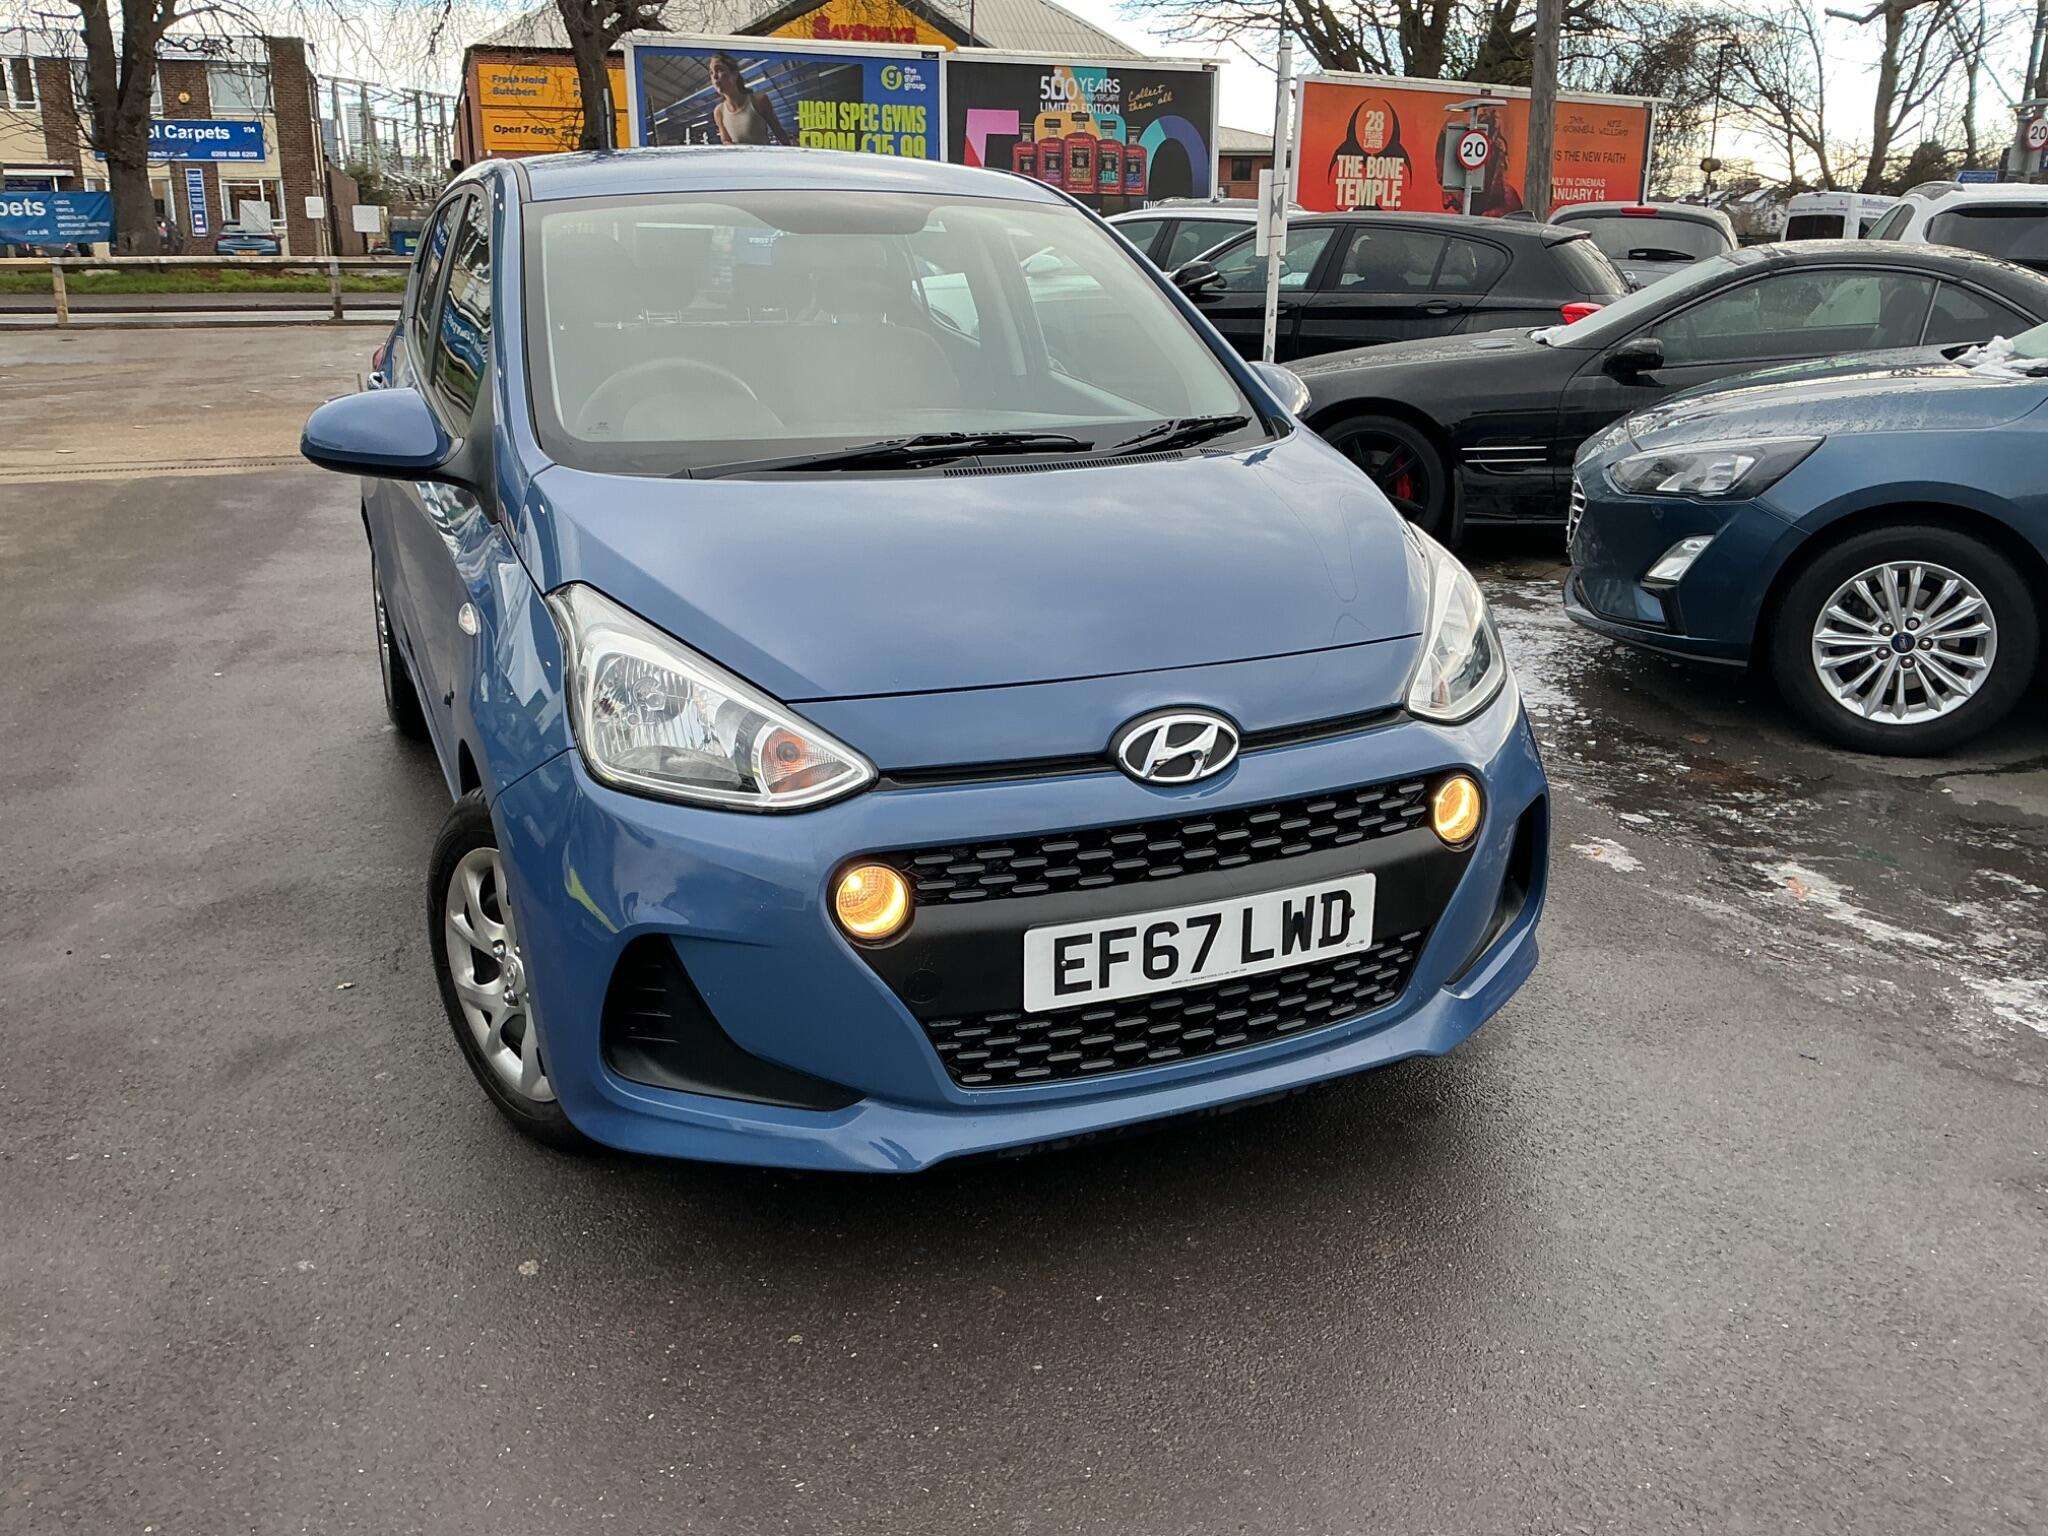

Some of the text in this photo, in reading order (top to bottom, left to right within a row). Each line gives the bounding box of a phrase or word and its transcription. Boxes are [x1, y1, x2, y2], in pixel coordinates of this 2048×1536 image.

[904, 67, 917, 75] the
[492, 74, 519, 84] Fresh
[904, 75, 921, 83] gym
[1079, 77, 1121, 94] YEARS
[492, 87, 537, 96] Butchers
[904, 83, 926, 92] group
[1128, 85, 1165, 102] Collect
[1040, 102, 1120, 114] LIMITED EDITION
[1128, 91, 1174, 112] them all
[798, 100, 927, 134] HIGH SPEC GYMS
[1366, 111, 1385, 131] 28
[164, 125, 231, 142] Carpets
[493, 125, 522, 135] Open
[530, 125, 556, 135] days
[2030, 125, 2047, 140] 20
[1463, 141, 1486, 157] 20
[1564, 151, 1580, 162] THE
[1582, 151, 1602, 163] NEW
[1602, 152, 1626, 164] FAITH
[1337, 155, 1405, 180] THE BONE
[1552, 176, 1606, 188] NLY IN CINEMAS
[1552, 188, 1605, 201] ANUARY 14
[1053, 889, 1353, 996] EF67 LWD
